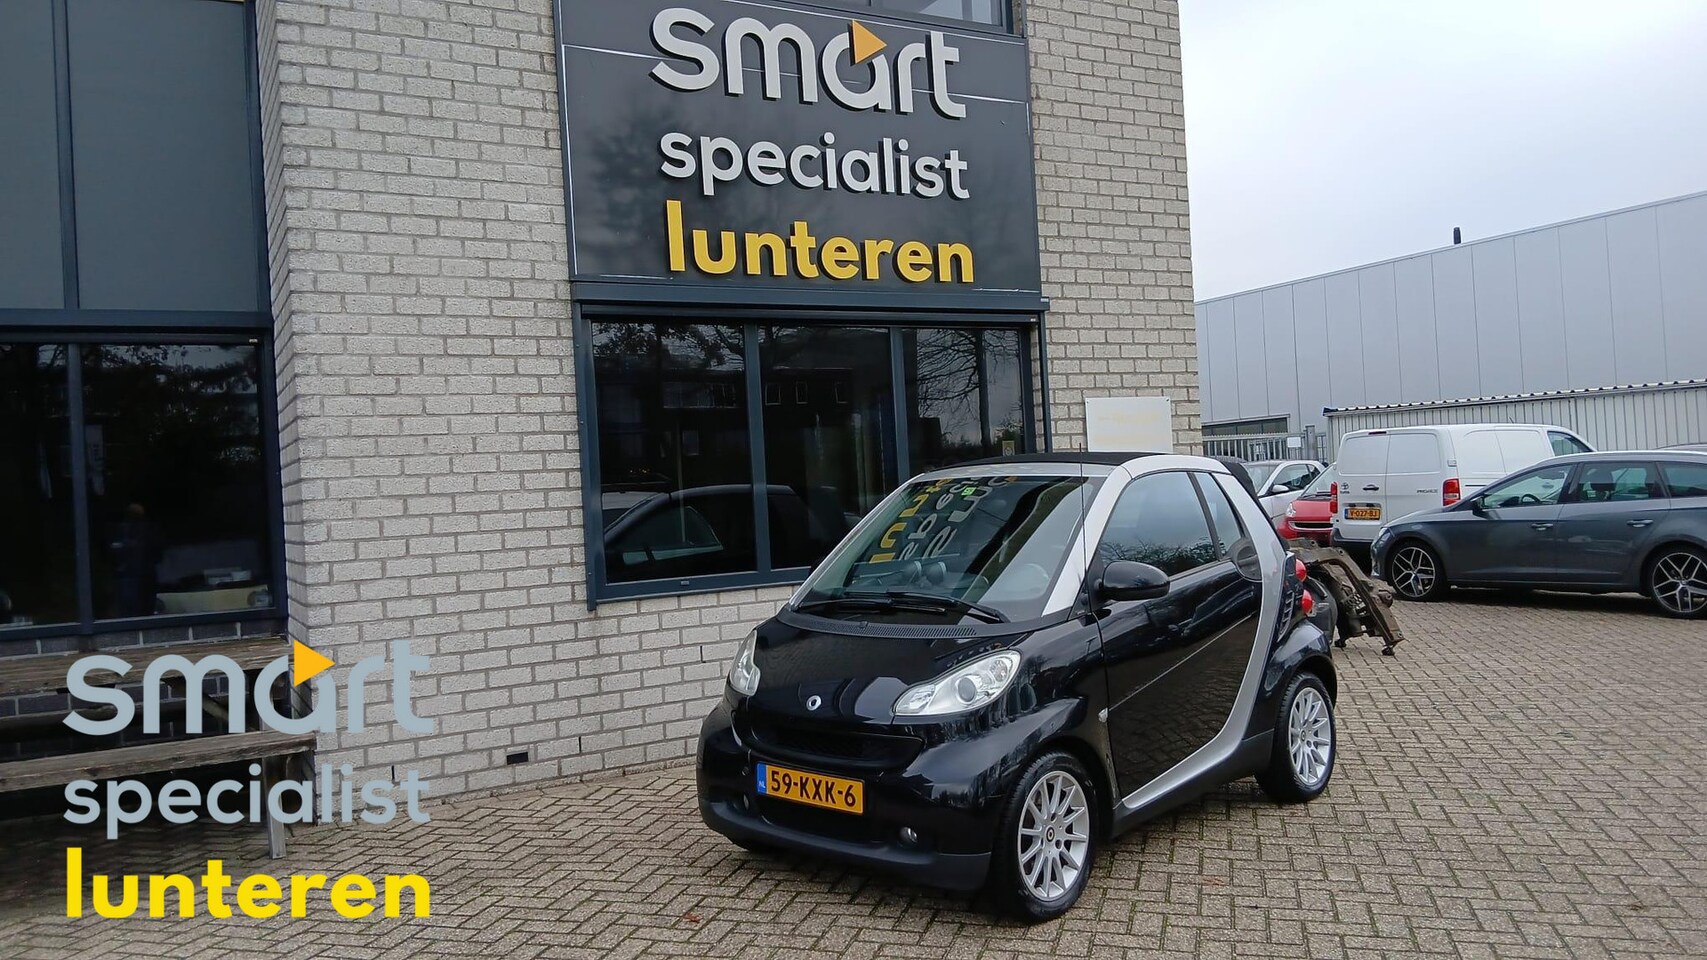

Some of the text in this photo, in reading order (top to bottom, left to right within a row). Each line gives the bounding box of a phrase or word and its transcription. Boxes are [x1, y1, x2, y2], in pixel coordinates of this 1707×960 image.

[650, 8, 967, 118] smart
[659, 131, 970, 199] specialist
[665, 199, 975, 283] lunteren
[1349, 508, 1378, 518] V-027-BJ
[771, 769, 857, 808] 59-KXK-6
